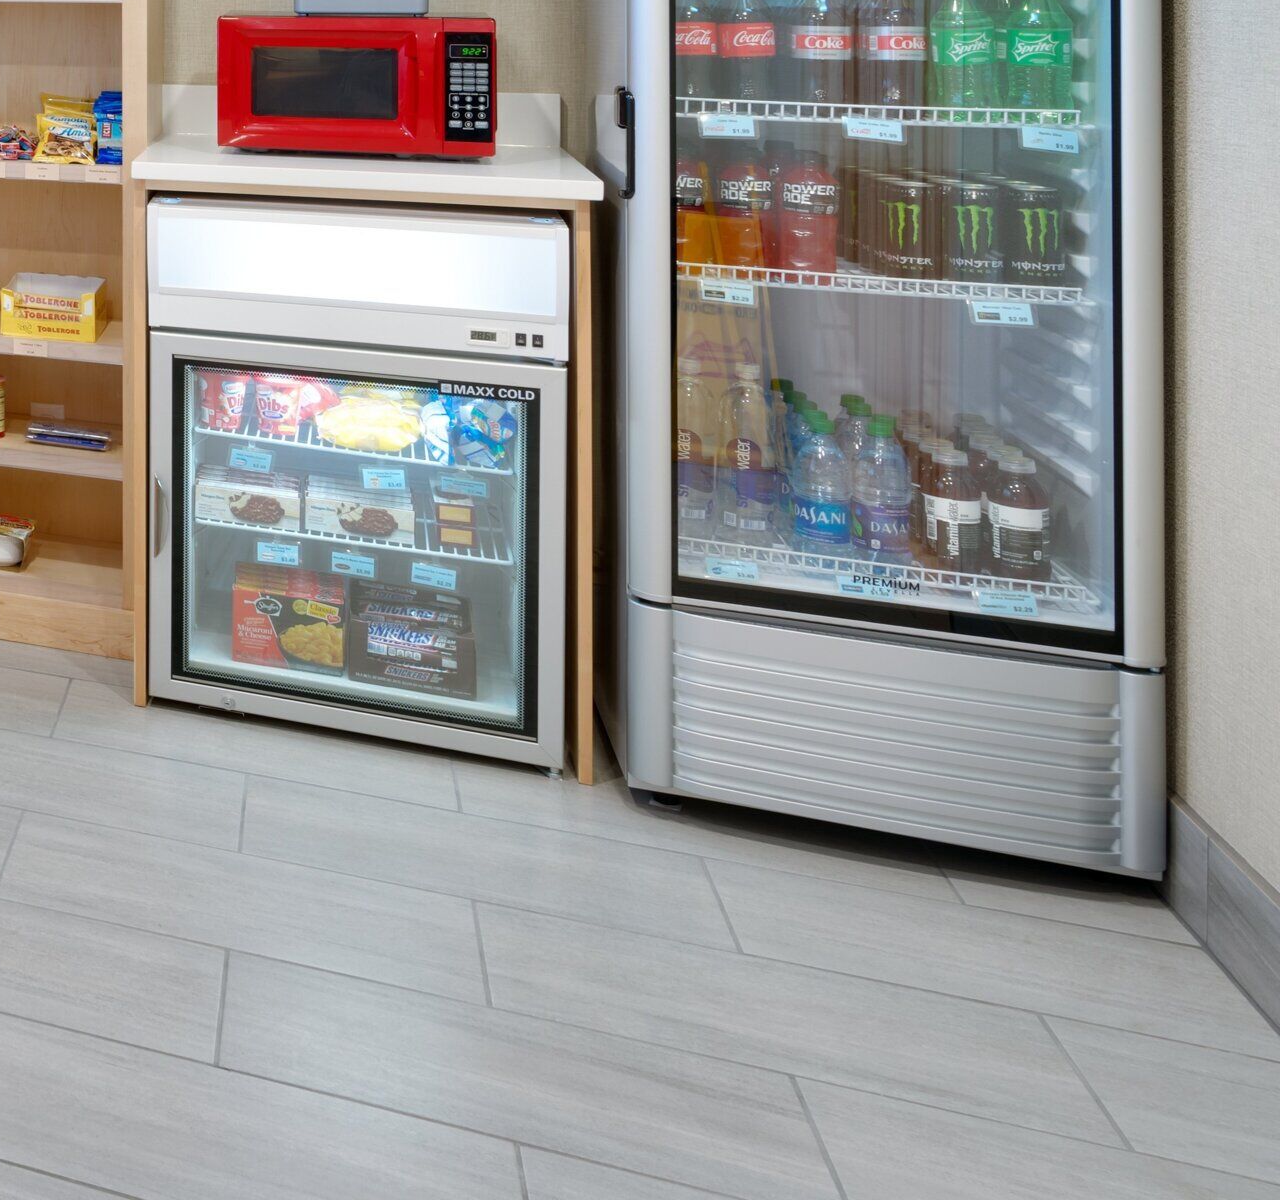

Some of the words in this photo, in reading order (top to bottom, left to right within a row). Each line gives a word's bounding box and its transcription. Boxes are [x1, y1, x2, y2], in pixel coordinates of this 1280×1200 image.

[804, 36, 843, 50] Coke
[889, 36, 927, 50] Coke
[951, 39, 988, 55] Sprite
[1014, 40, 1055, 55] Sprite
[62, 127, 91, 137] Amos
[784, 183, 836, 196] POWER
[25, 294, 80, 308] TOBLERONE
[25, 311, 80, 323] TOBLERONE
[37, 325, 80, 335] TOBLERONE
[454, 385, 494, 397] MAXX
[498, 389, 536, 401] COLD
[257, 396, 289, 414] Dibs
[738, 437, 752, 471] water
[308, 602, 337, 615] Classic
[236, 623, 274, 635] Macaroni
[367, 623, 433, 646] SNICKERS
[385, 664, 430, 681] SNICKERS
